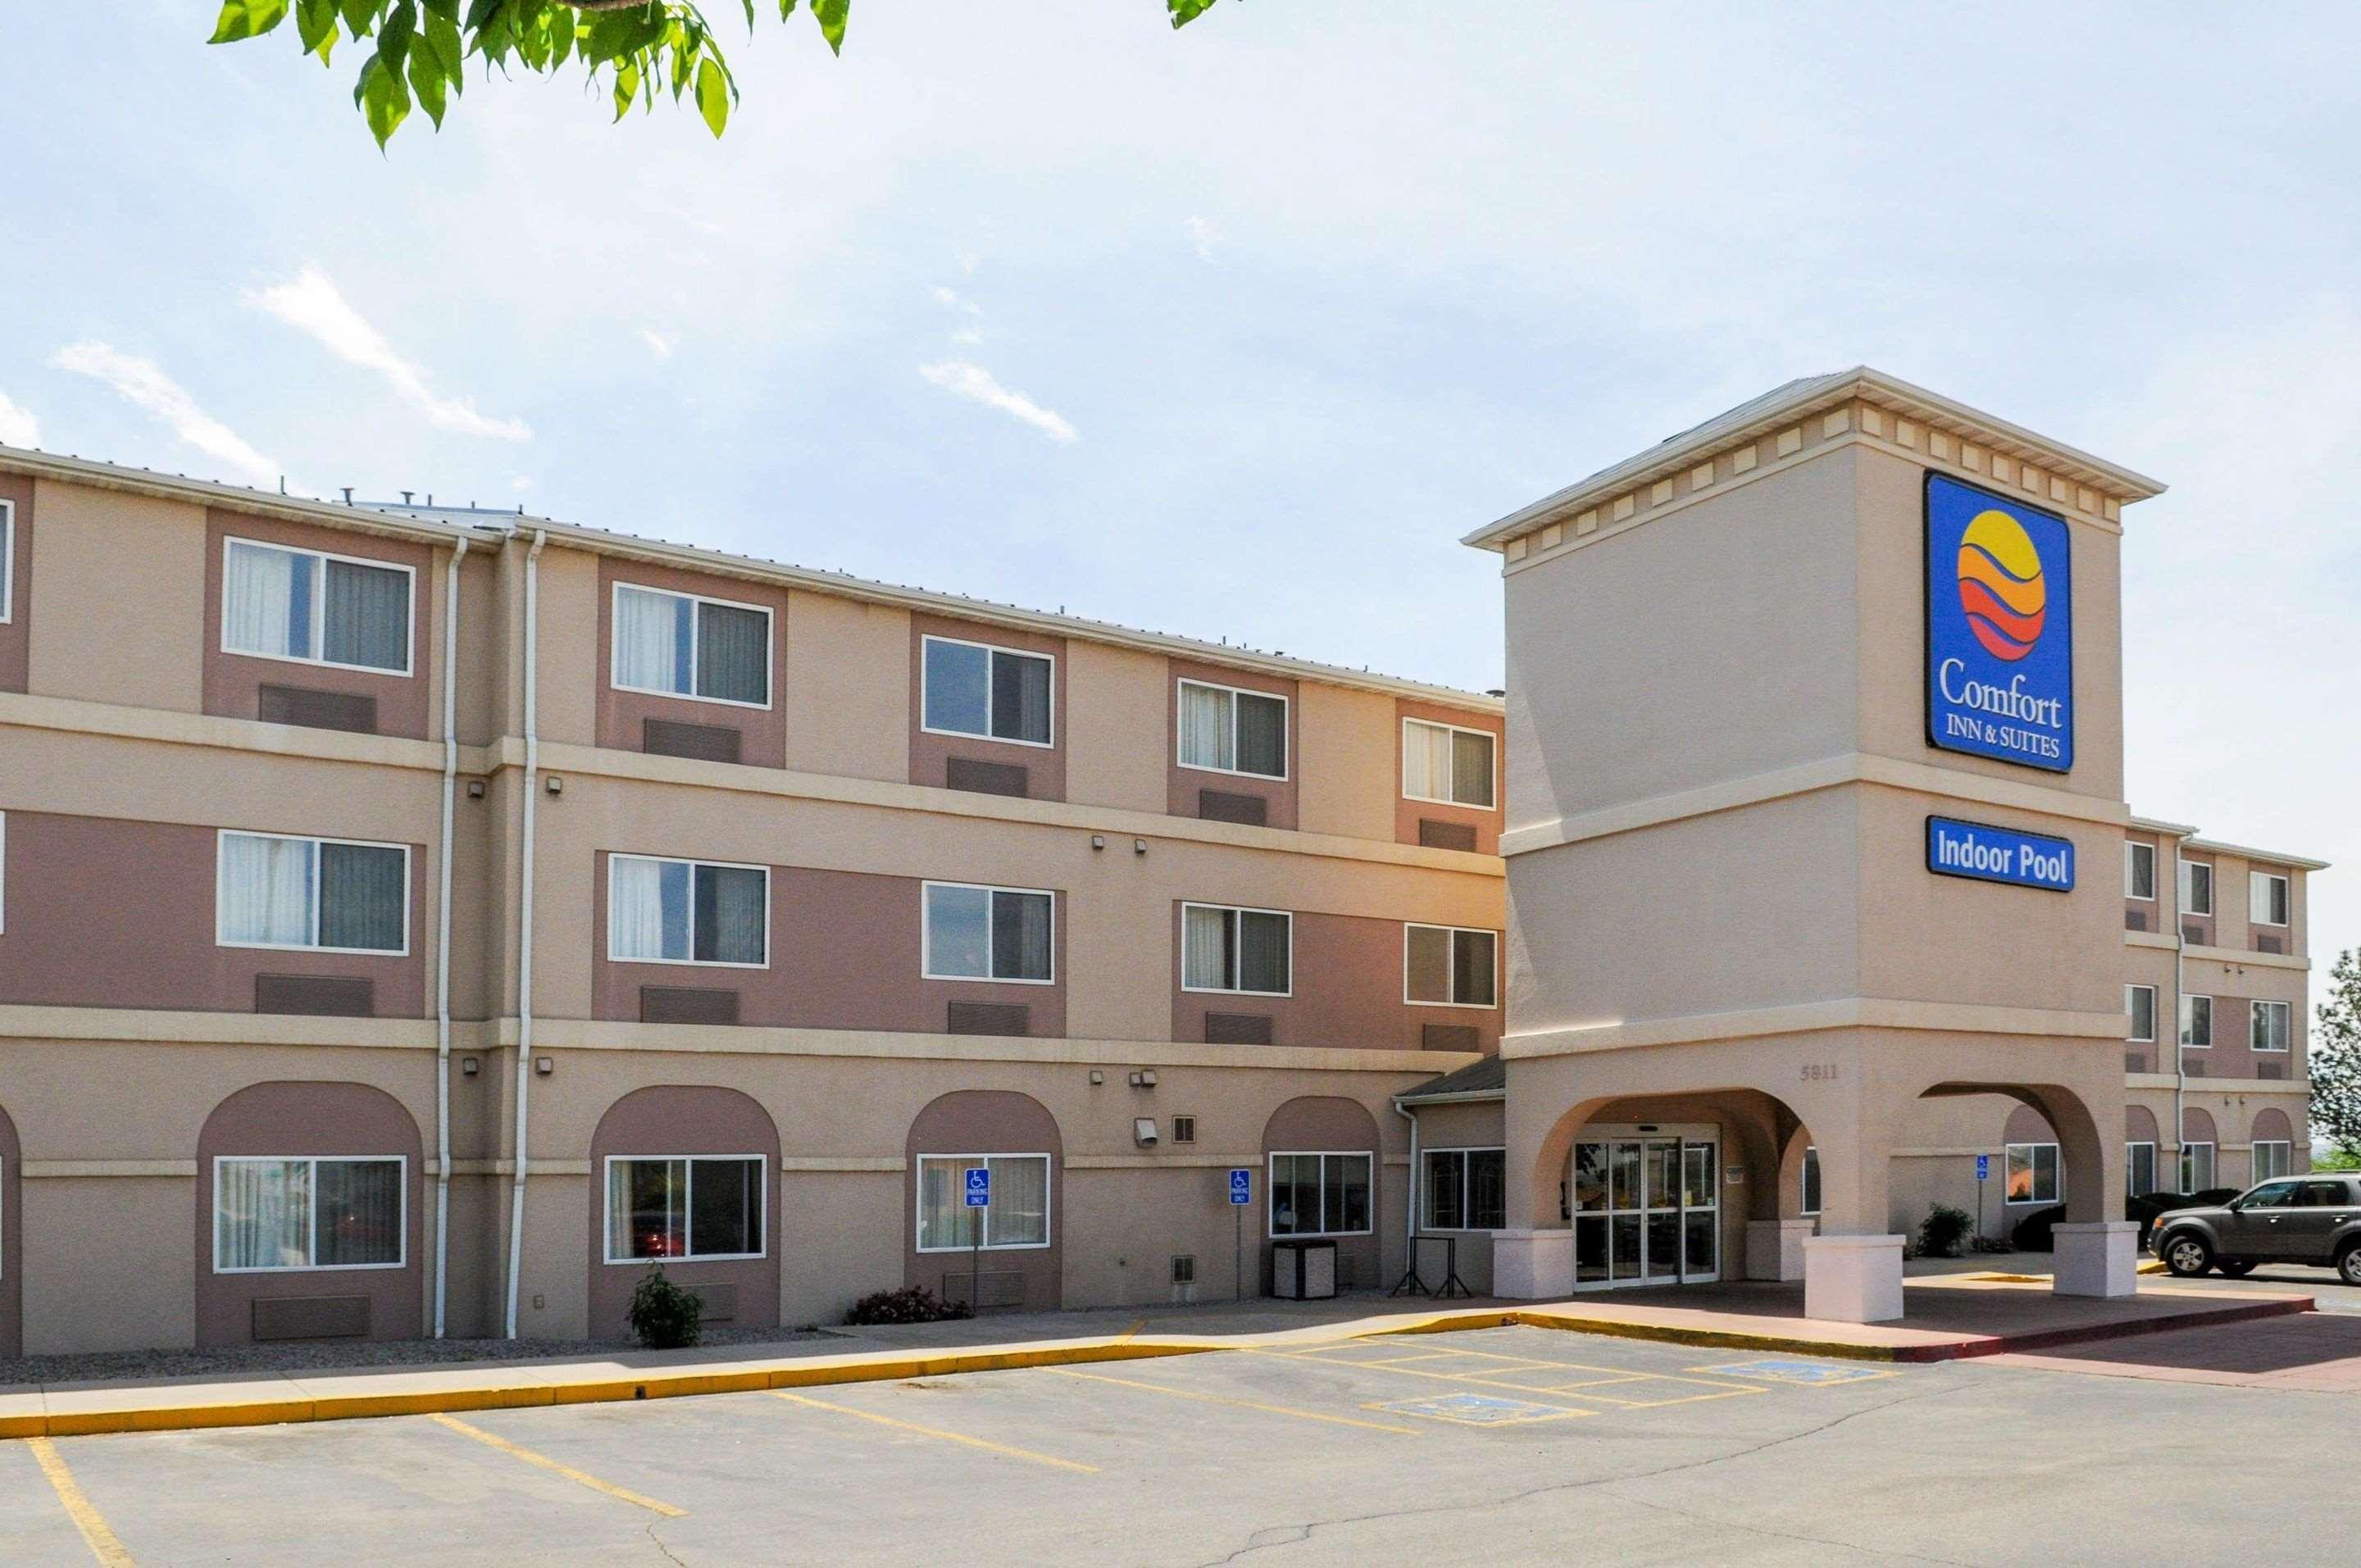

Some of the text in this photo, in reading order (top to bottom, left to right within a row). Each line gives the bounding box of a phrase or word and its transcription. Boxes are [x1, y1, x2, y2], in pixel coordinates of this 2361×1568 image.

[1939, 657, 2062, 729] Comfort
[1946, 713, 2060, 759] INN & SUITES
[1939, 829, 2068, 884] Indoor Pool
